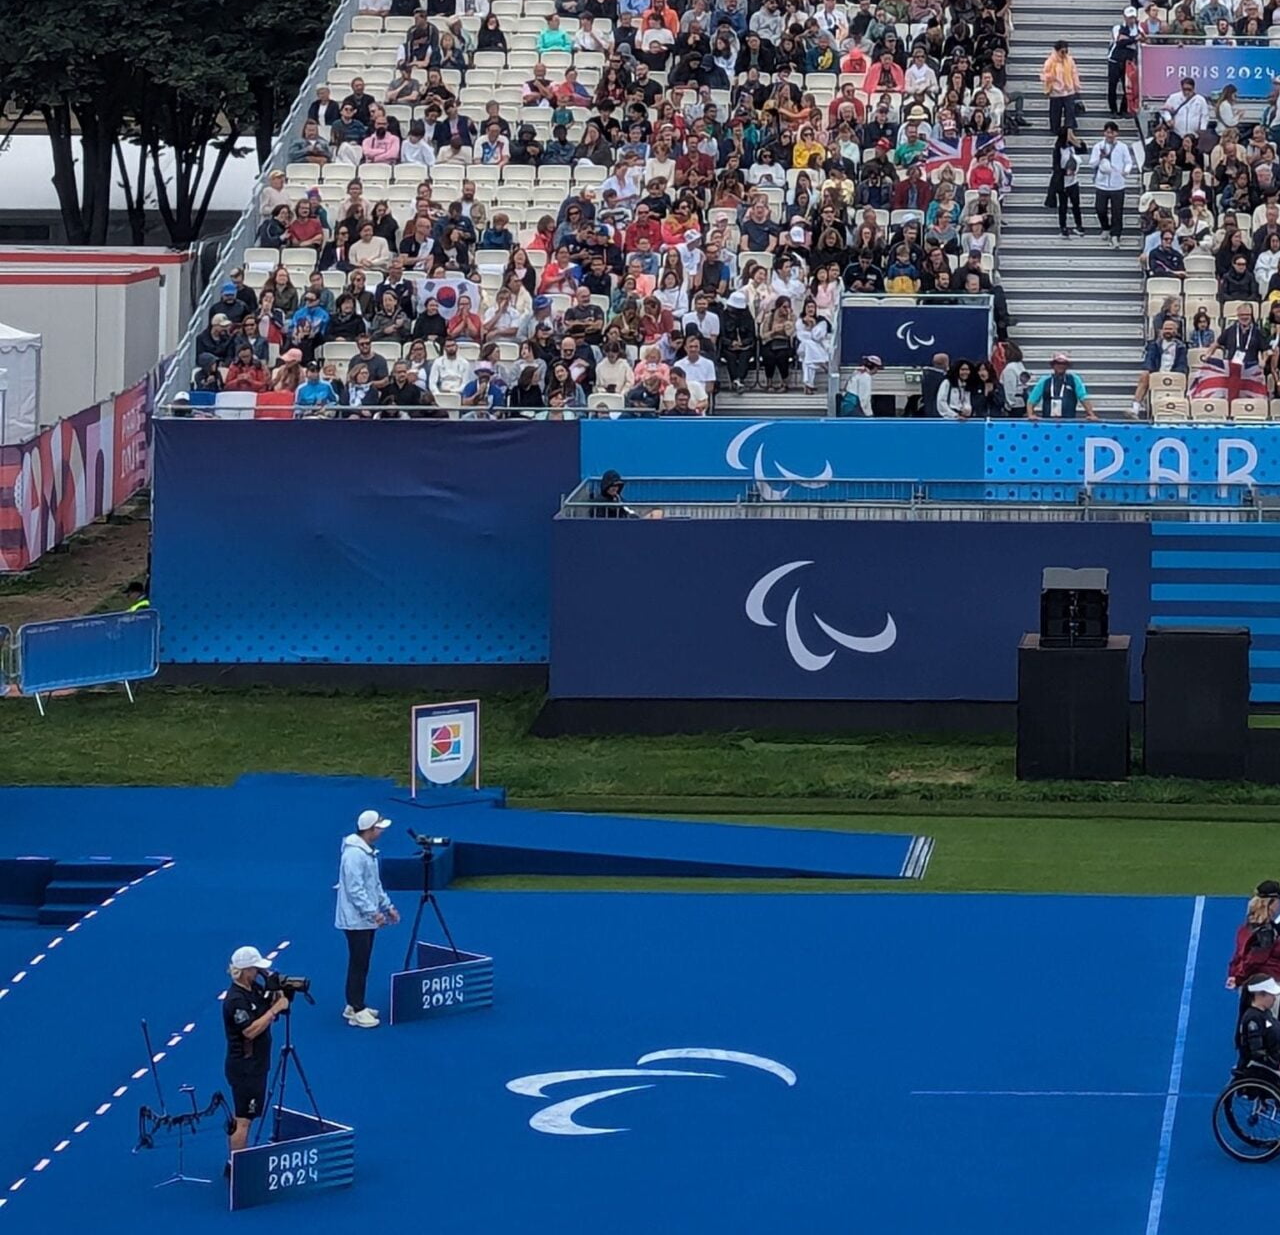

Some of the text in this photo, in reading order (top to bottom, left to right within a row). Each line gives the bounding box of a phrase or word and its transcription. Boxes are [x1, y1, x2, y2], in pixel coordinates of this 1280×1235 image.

[1165, 65, 1275, 79] PARIS 2024
[422, 974, 464, 994] PARIS
[422, 990, 464, 1009] 2024
[268, 1148, 319, 1172] PARIS
[268, 1167, 319, 1191] 2024
